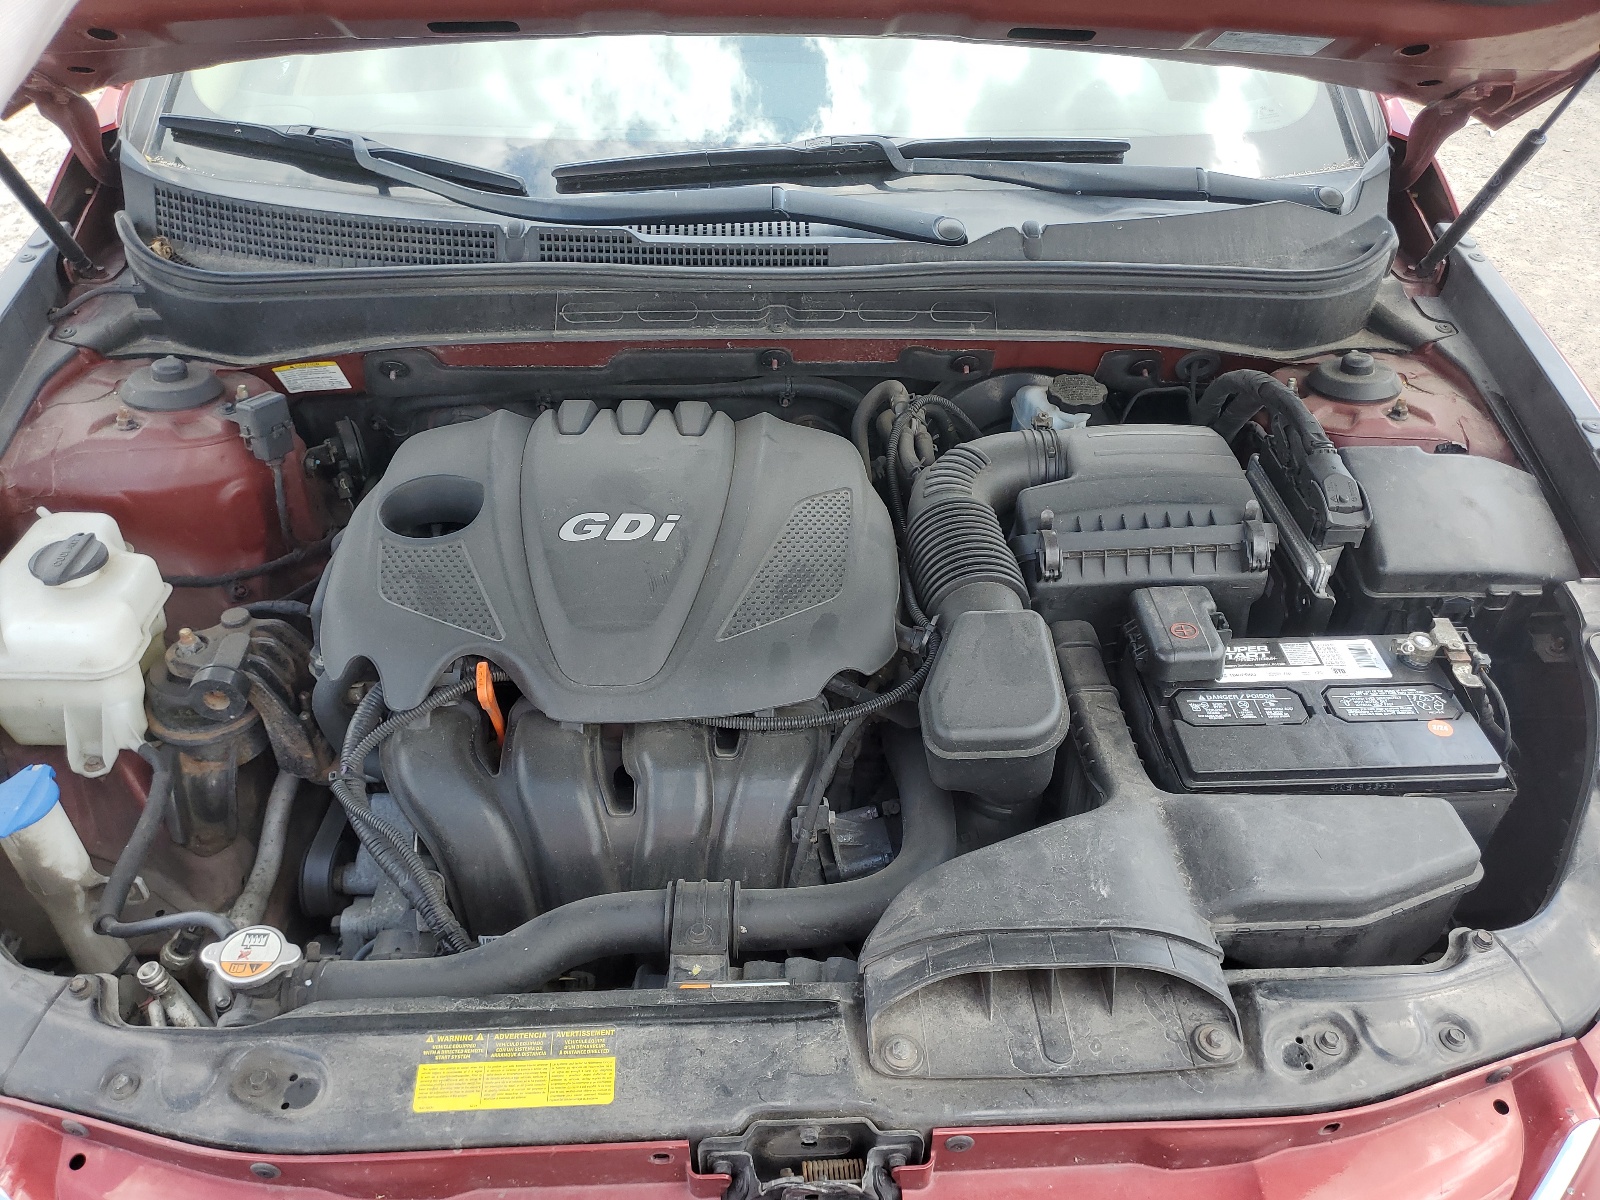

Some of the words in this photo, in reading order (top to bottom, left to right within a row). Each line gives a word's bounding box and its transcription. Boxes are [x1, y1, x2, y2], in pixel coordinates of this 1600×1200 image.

[558, 512, 682, 542] GDi
[1225, 651, 1271, 660] TART
[437, 1034, 474, 1042] WARNING
[494, 1032, 547, 1040] ADVERTENCIA
[556, 1029, 615, 1038] AVERTISSEMENT
